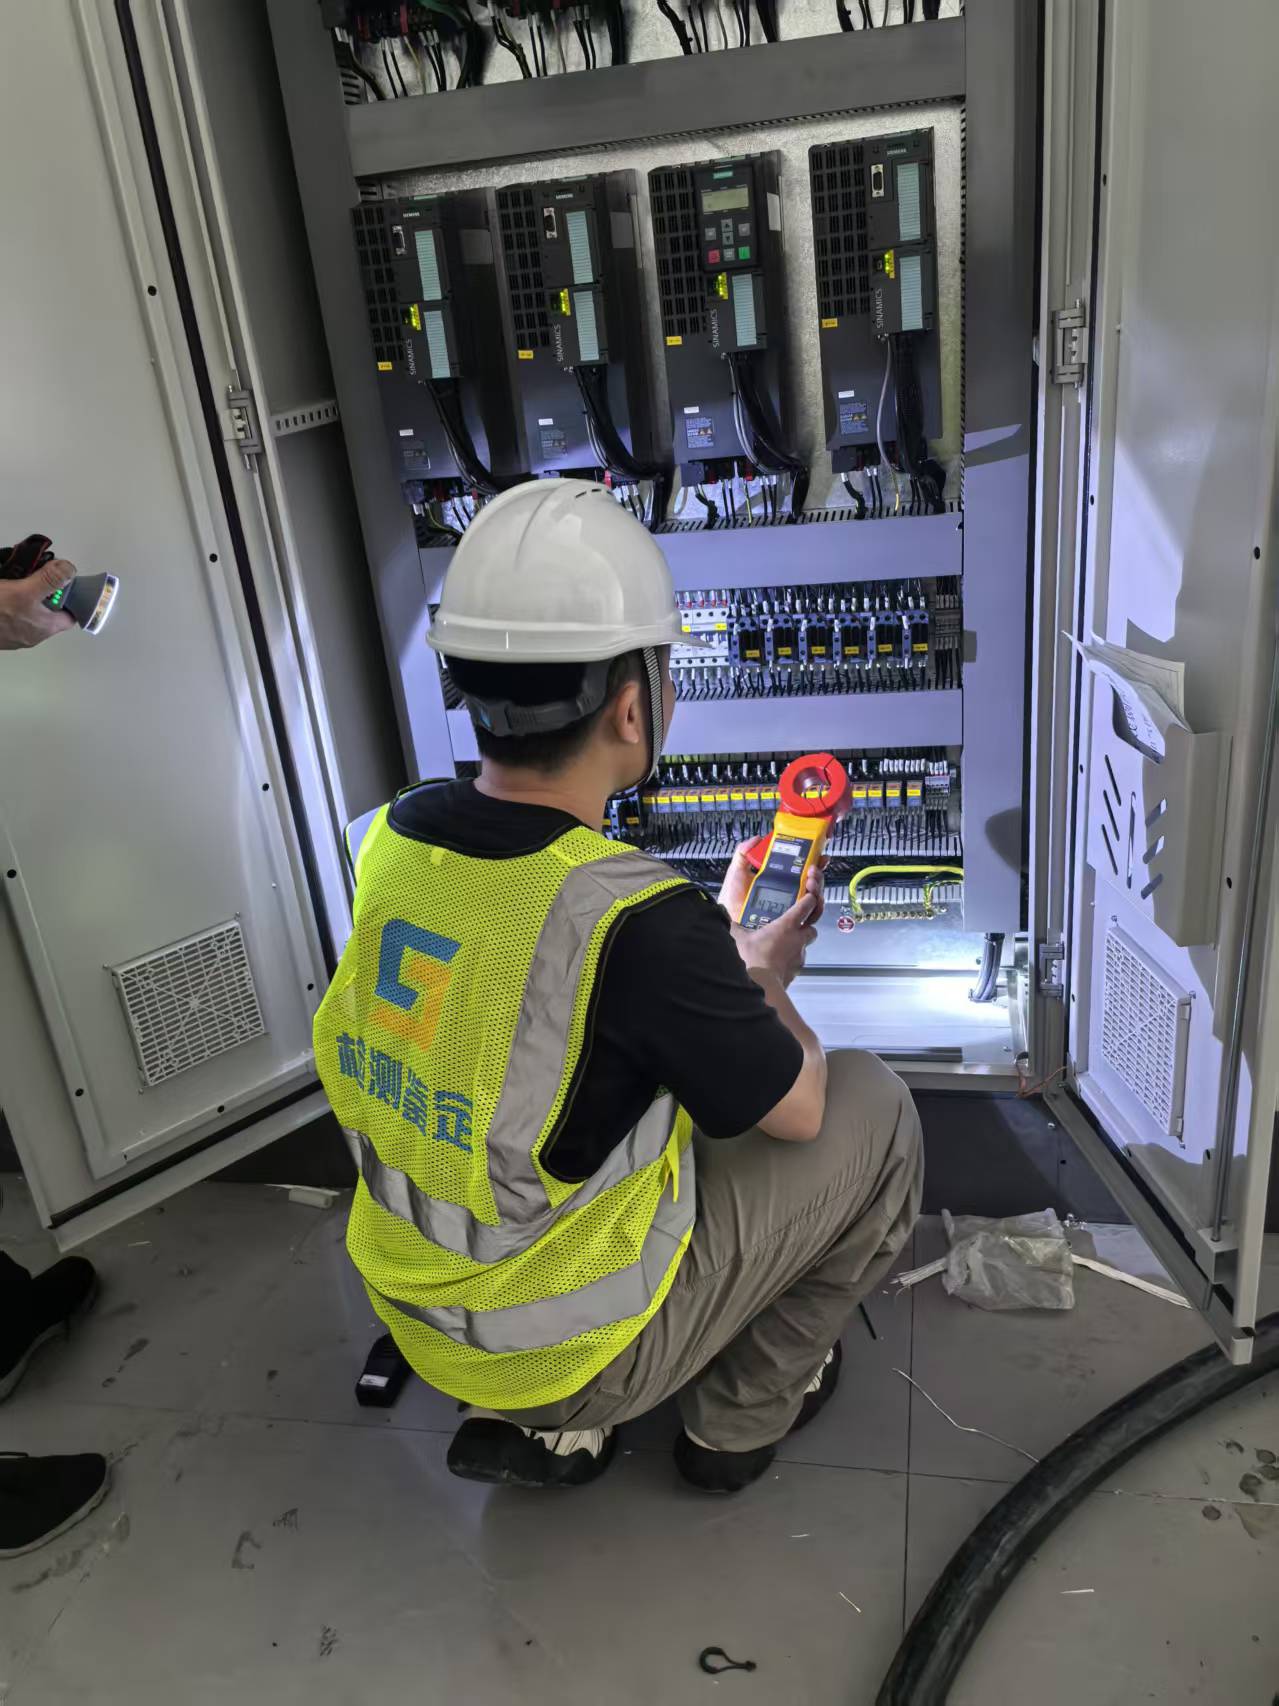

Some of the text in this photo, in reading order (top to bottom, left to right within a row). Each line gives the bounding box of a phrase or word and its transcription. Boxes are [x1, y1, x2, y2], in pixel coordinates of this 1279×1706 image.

[877, 288, 885, 328] SINAMICS
[554, 324, 564, 362] SINAMICS
[712, 309, 721, 349] SINAMICS
[408, 338, 417, 377] SINAMICS
[336, 1032, 474, 1153] 检测鉴定
